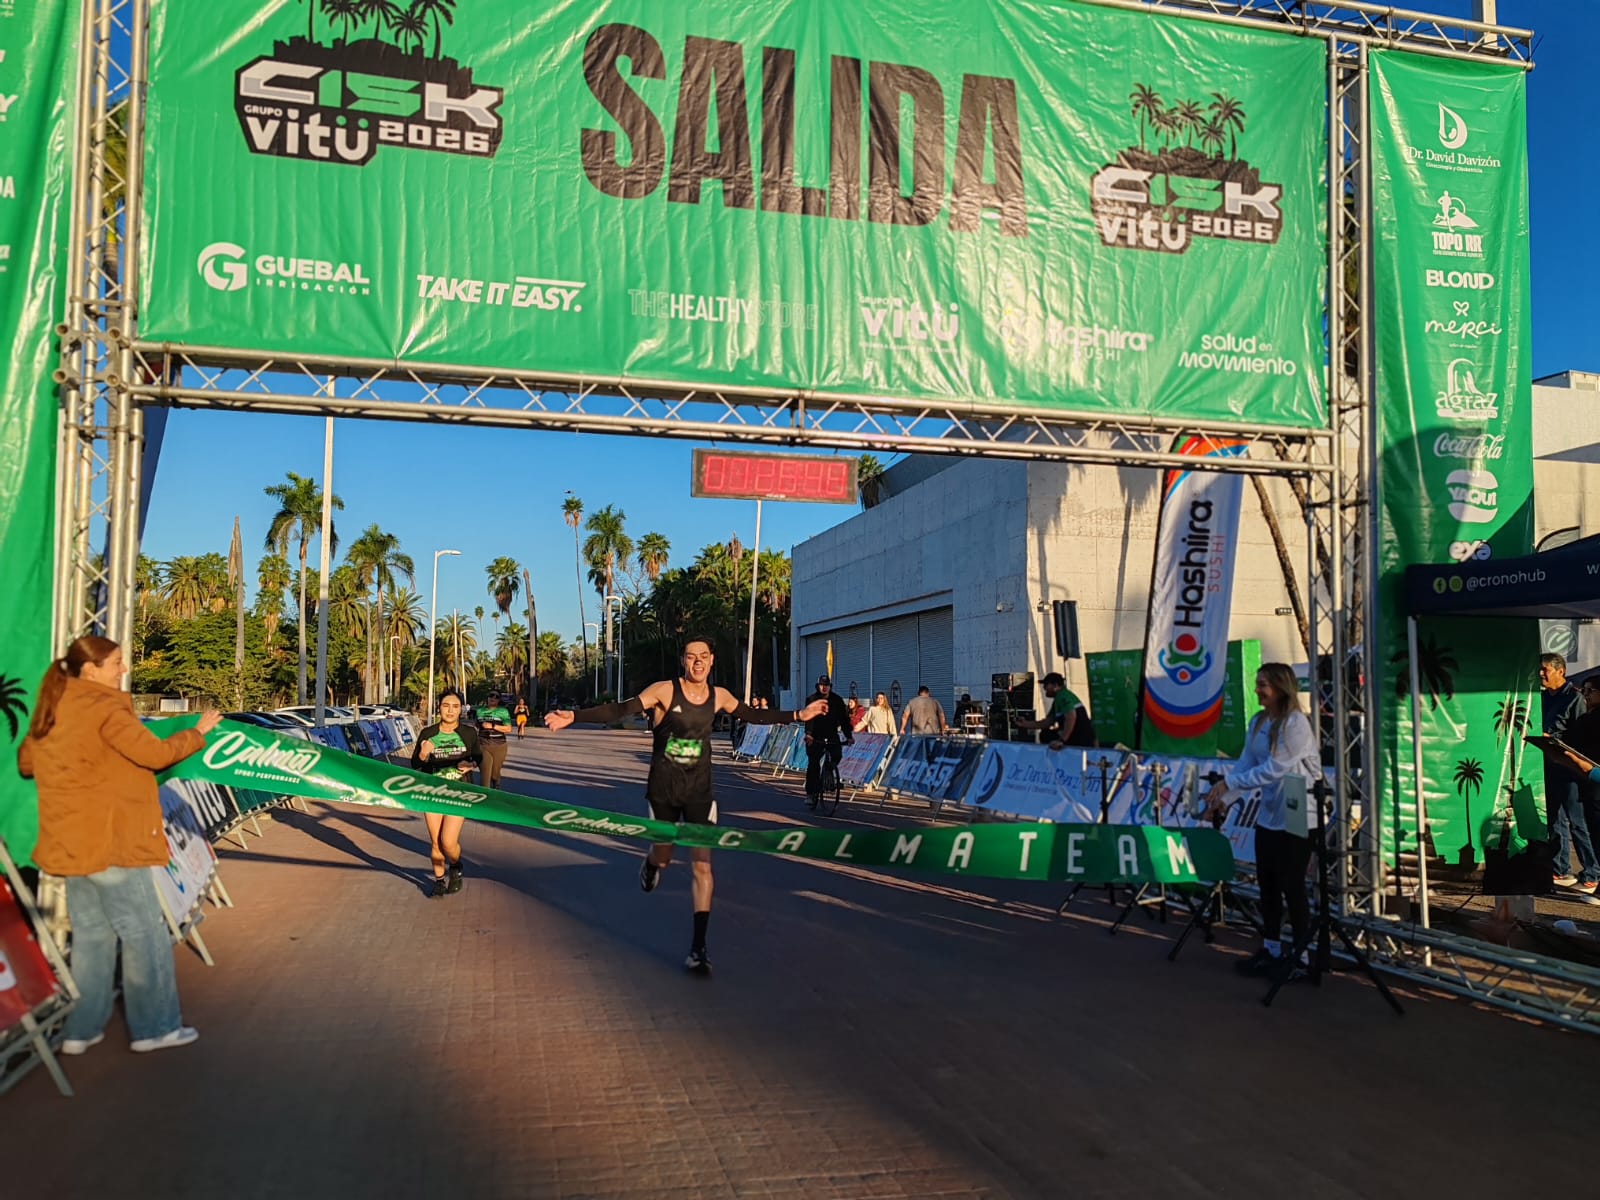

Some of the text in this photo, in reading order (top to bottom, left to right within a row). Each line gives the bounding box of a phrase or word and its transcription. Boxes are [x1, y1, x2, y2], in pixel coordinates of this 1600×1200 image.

[244, 104, 283, 117] GRUPO
[378, 120, 490, 153] 2026
[580, 22, 1029, 238] SALIDA
[1408, 146, 1501, 168] Dr. David Davizón
[1192, 214, 1274, 241] 2026
[1431, 231, 1463, 251] TOPO
[255, 254, 370, 284] GUEBAL
[1426, 269, 1495, 290] BLOND
[256, 277, 370, 295] IRRIGACIÓN
[416, 274, 484, 303] TAKE
[486, 281, 510, 305] IT
[670, 293, 753, 324] HEALTHY
[1201, 333, 1273, 354] salud en
[1435, 391, 1499, 413] agraz
[1207, 534, 1225, 593] SUSHI
[1466, 568, 1547, 591] @cronohub
[202, 731, 321, 775] Calma
[233, 769, 300, 784] SPORT PERFORMANCE
[382, 774, 488, 803] Calma
[410, 794, 473, 808] SPORT PERFORMANCE
[543, 809, 647, 836] Calma
[718, 830, 974, 870] CALMA
[1019, 831, 1196, 876] TEAM
